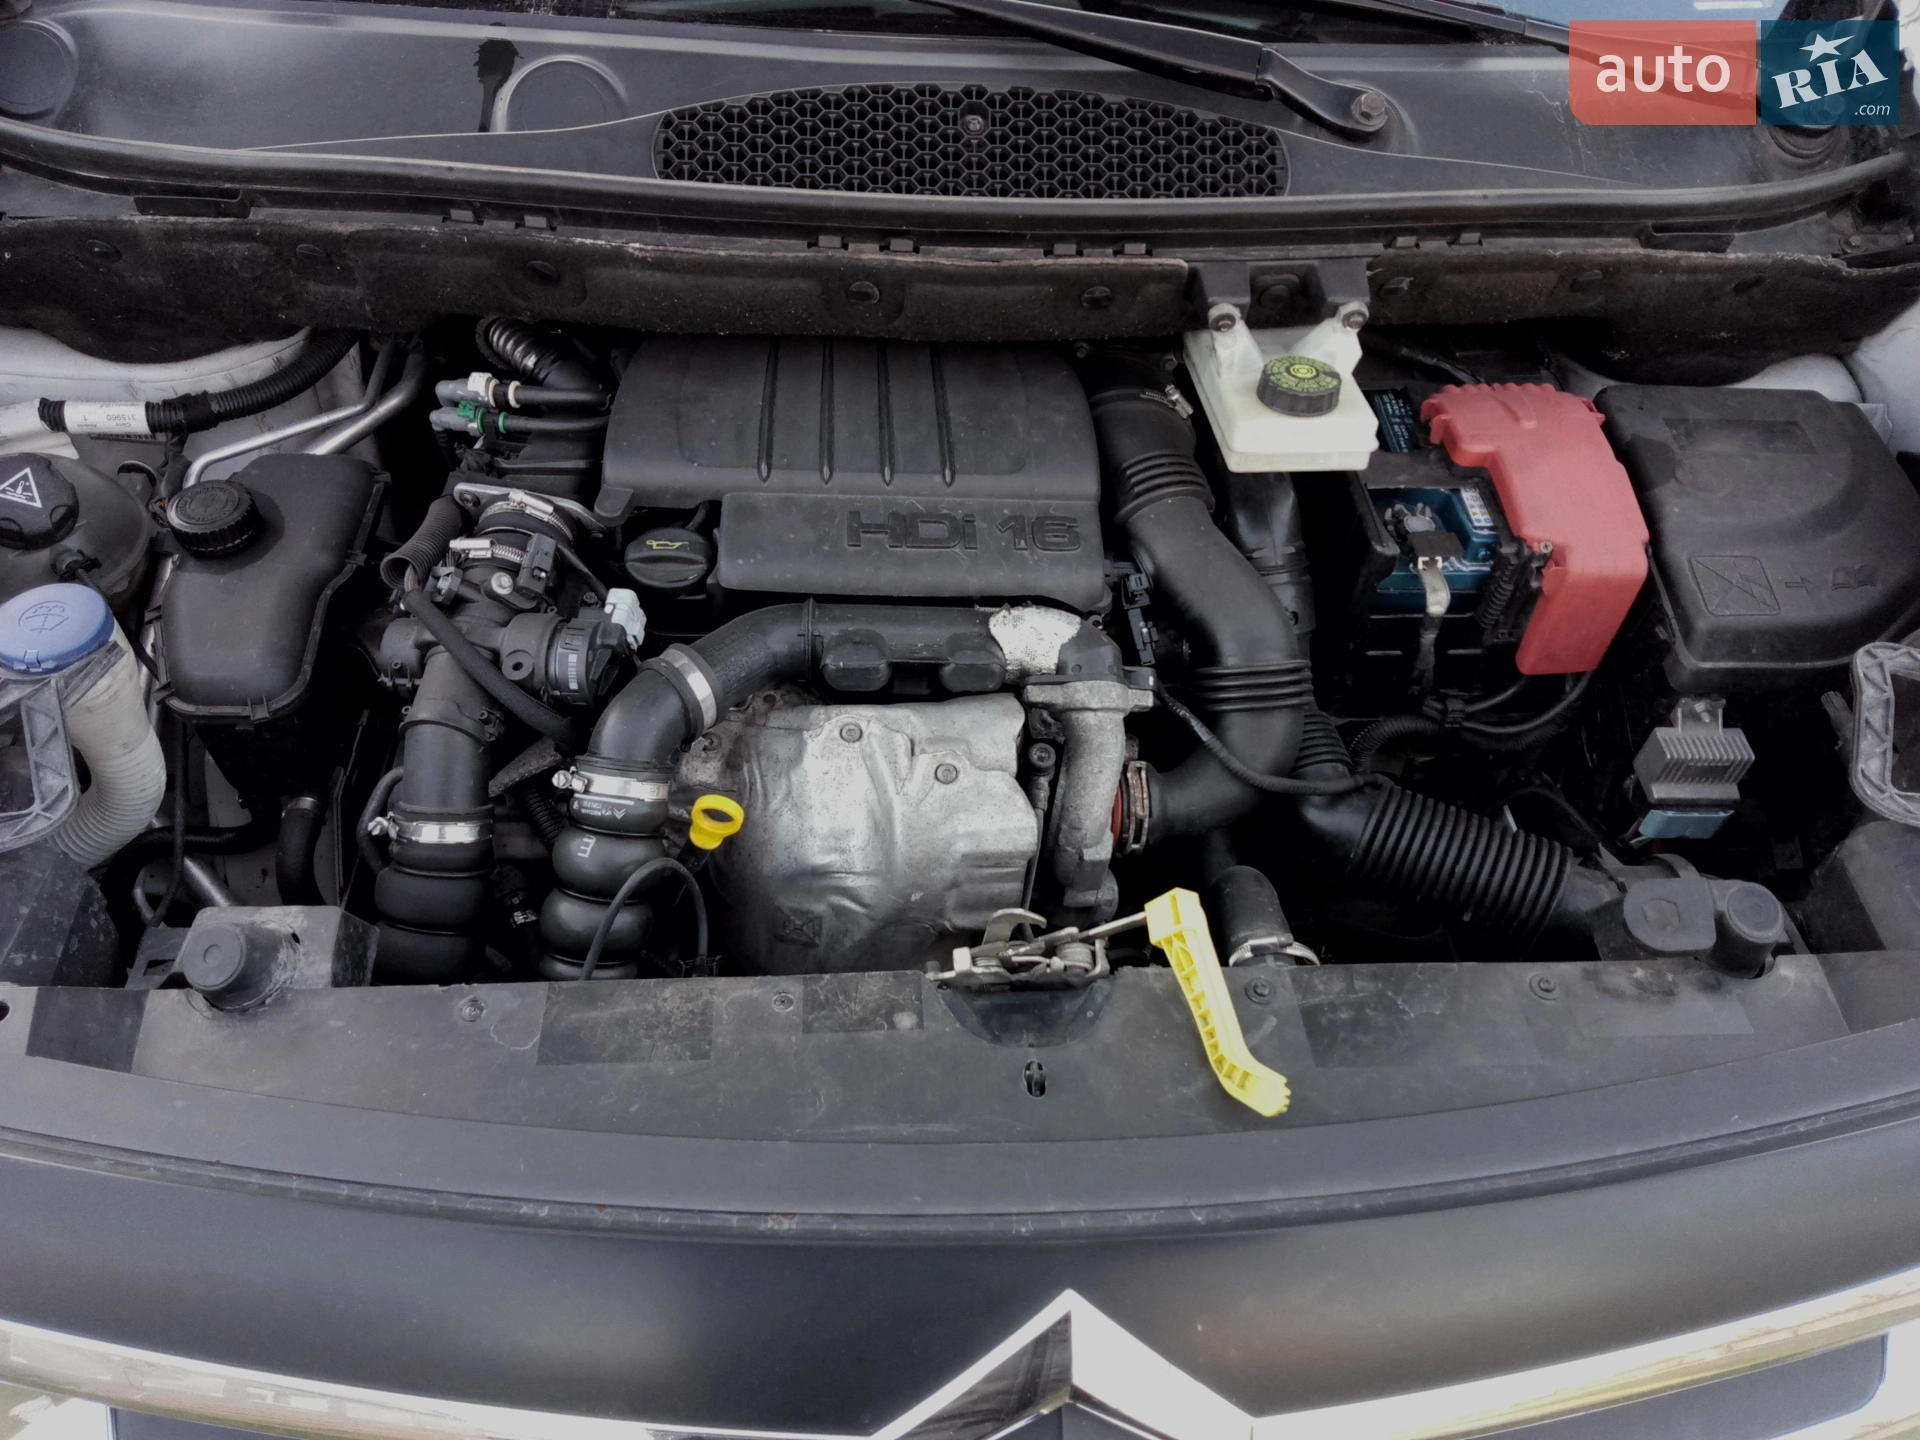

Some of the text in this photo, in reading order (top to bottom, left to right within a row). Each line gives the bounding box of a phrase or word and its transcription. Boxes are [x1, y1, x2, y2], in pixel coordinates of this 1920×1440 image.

[105, 413, 137, 421] 315960
[846, 510, 1081, 552] HDi 16
